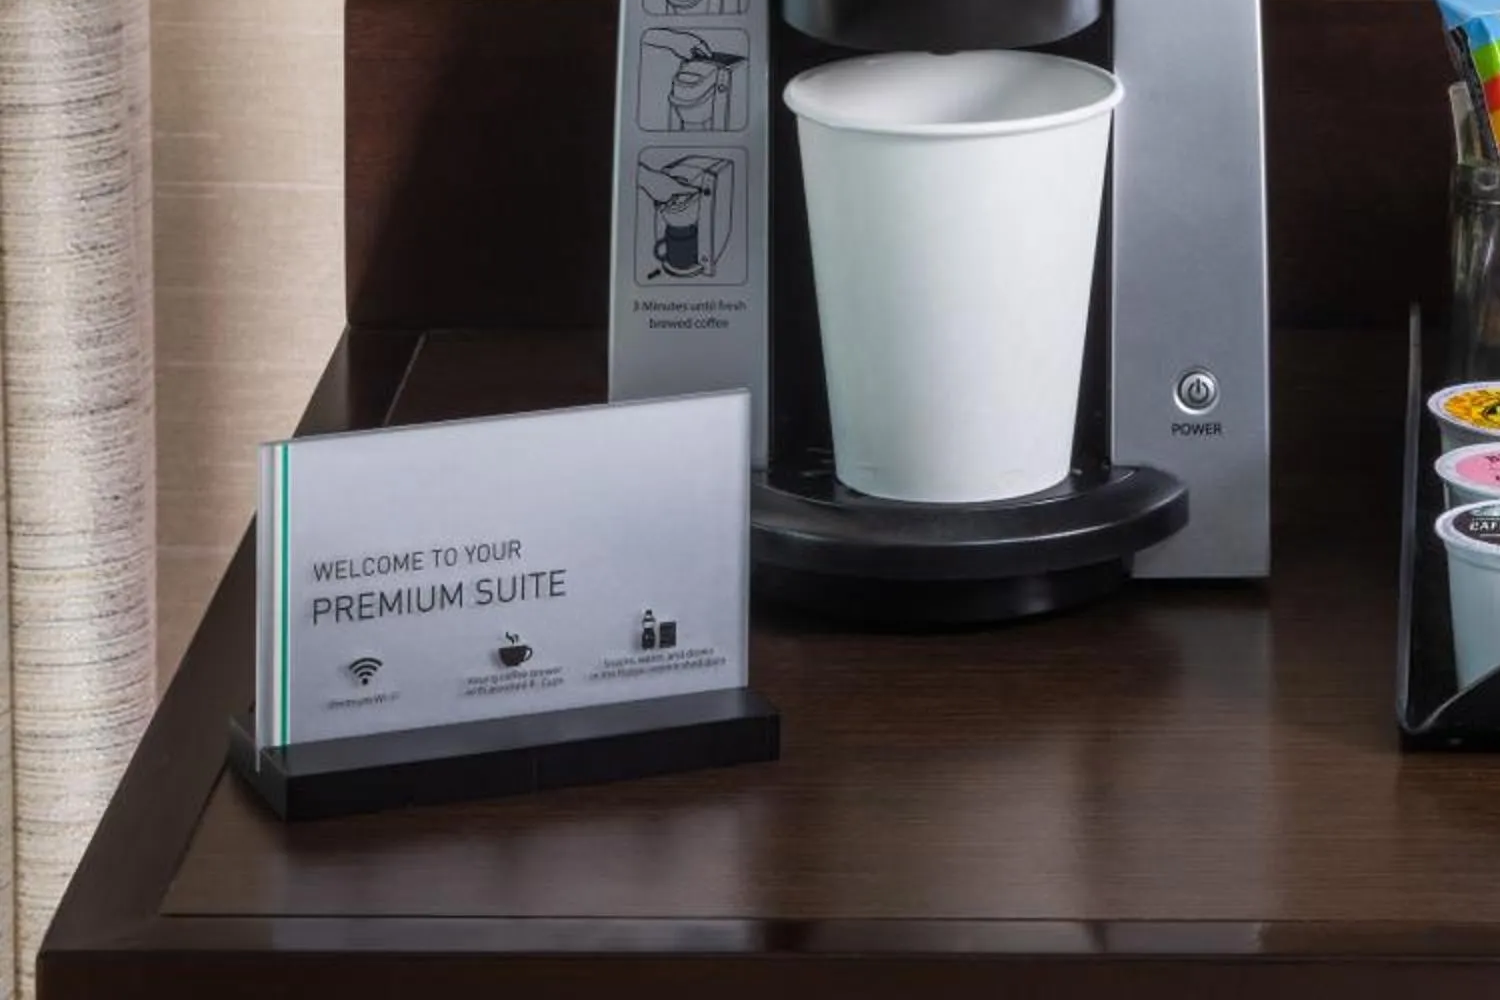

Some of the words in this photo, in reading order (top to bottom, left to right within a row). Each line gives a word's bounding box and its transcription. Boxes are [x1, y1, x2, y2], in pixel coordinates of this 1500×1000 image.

[694, 317, 730, 330] coffee
[1170, 422, 1222, 436] POWER
[313, 551, 425, 582] WELCOME
[432, 547, 458, 567] TO
[464, 539, 523, 564] YOUR
[312, 581, 464, 626] PREMIUM
[475, 568, 568, 606] SUITE
